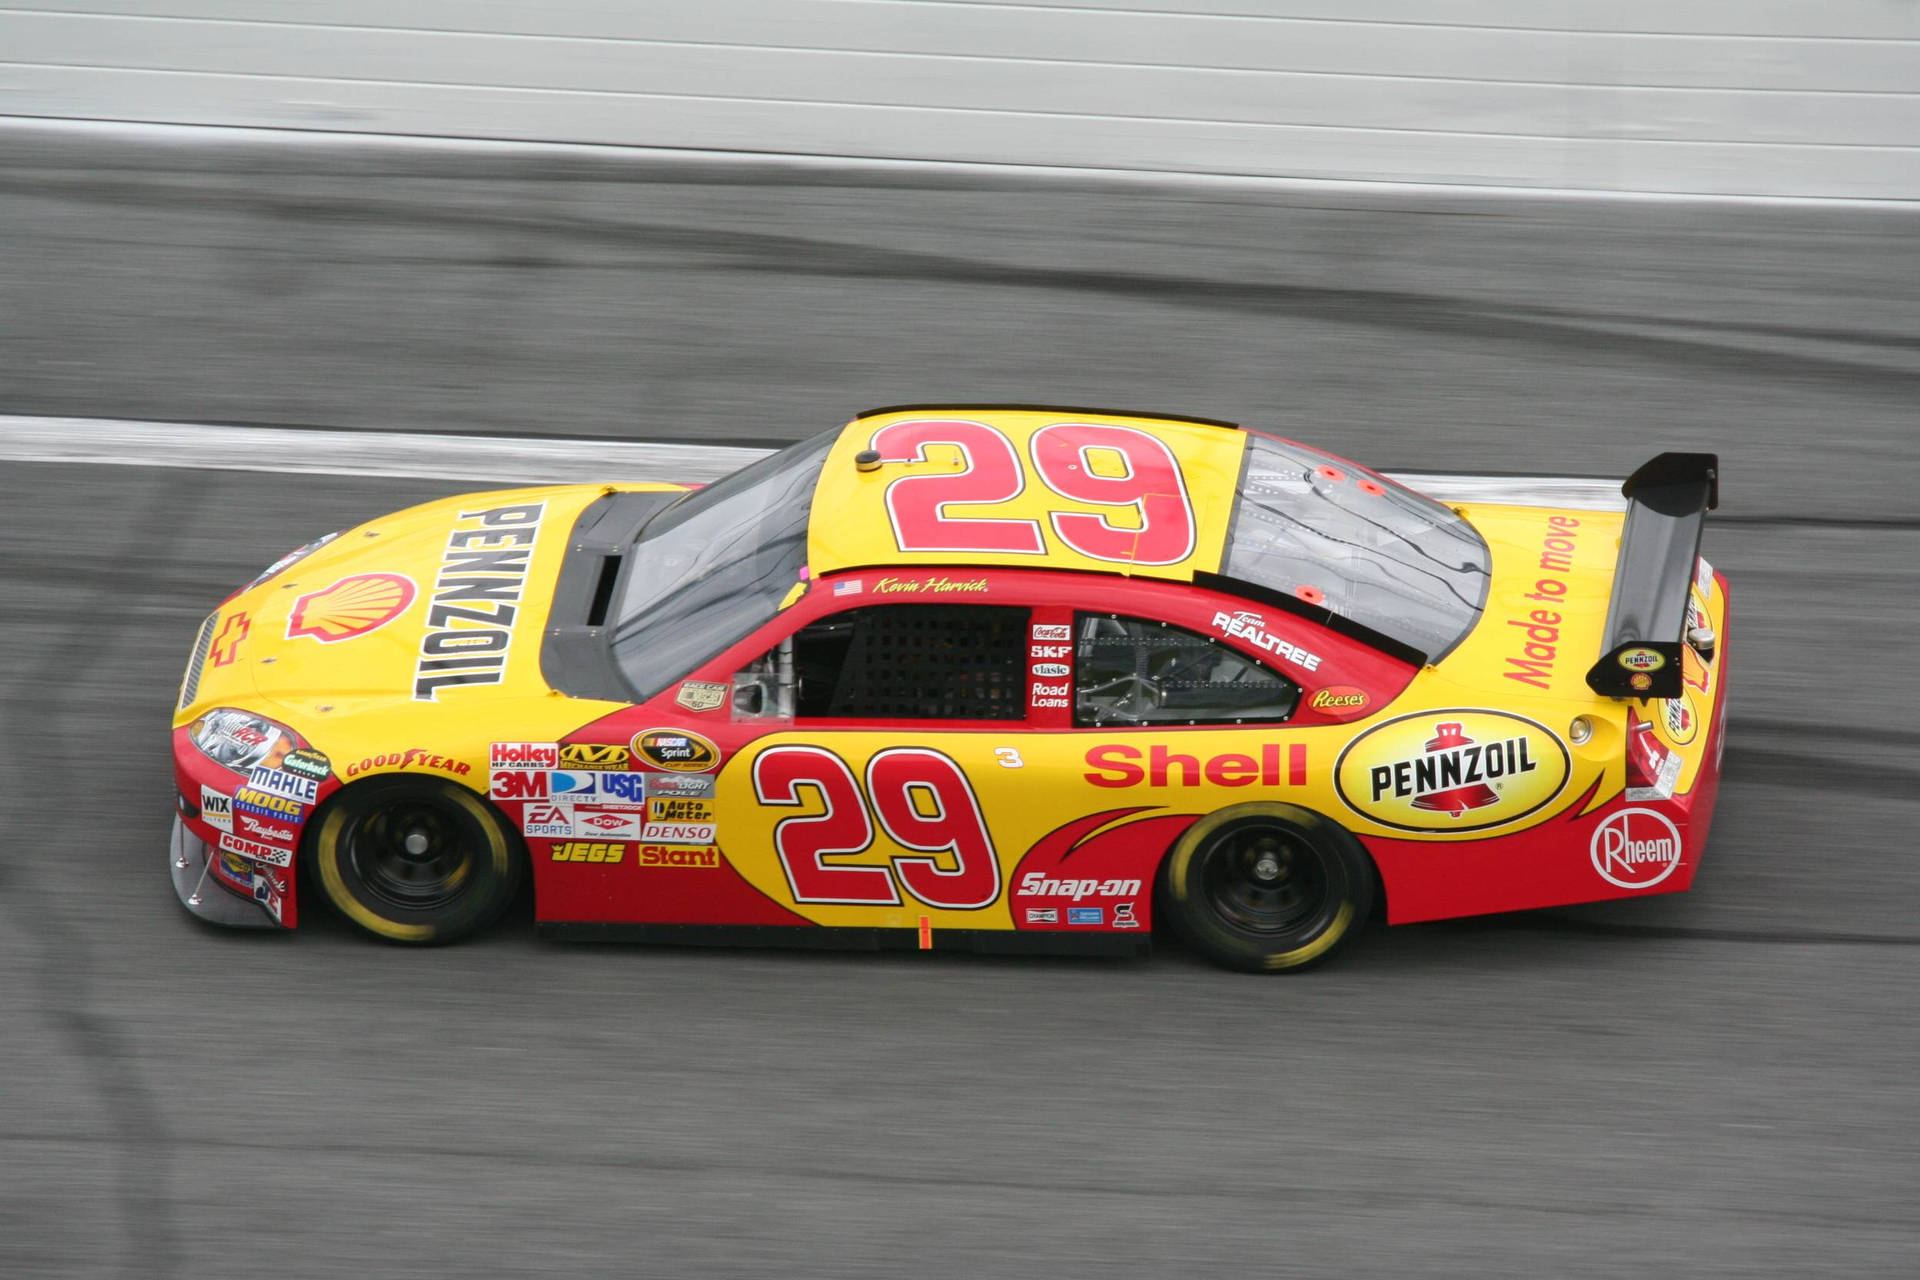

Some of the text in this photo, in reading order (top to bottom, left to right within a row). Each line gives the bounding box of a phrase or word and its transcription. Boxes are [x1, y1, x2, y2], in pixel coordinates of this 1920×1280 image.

[870, 418, 1197, 566] 29
[872, 577, 919, 593] Kevin
[411, 499, 548, 703] PENNZOIL
[1502, 515, 1581, 690] Made to move
[1233, 611, 1267, 627] Team
[1034, 627, 1067, 638] Coca-Cola
[1211, 611, 1322, 672] REALTREE
[1031, 645, 1072, 658] SKF
[1625, 655, 1658, 664] PENNZOIL
[1032, 682, 1069, 696] Road
[1312, 689, 1364, 707] Reese's
[1031, 695, 1069, 707] Loans
[656, 737, 688, 747] NASCAR
[491, 744, 556, 767] Holley
[661, 747, 691, 759] Sprint
[994, 747, 1024, 768] 3
[283, 754, 329, 776] Gatorback
[1083, 743, 1307, 789] Shell
[1370, 736, 1537, 802] PENNZOIL
[251, 765, 317, 800] MAHLE
[492, 772, 548, 798] 3M
[602, 773, 644, 803] USG
[678, 782, 711, 791] LIGHT
[202, 794, 230, 814] WIX
[235, 787, 303, 816] MOOG
[669, 800, 704, 810] Auto
[528, 805, 569, 824] EA
[665, 810, 712, 820] Meter
[526, 825, 572, 835] SPORTS
[646, 826, 712, 840] DENSO
[751, 743, 1002, 911] 29
[222, 835, 273, 857] COMP
[552, 842, 626, 863] JEGS
[1604, 814, 1673, 874] Rheem
[641, 846, 716, 866] Stant
[1017, 872, 1141, 901] Snap-on
